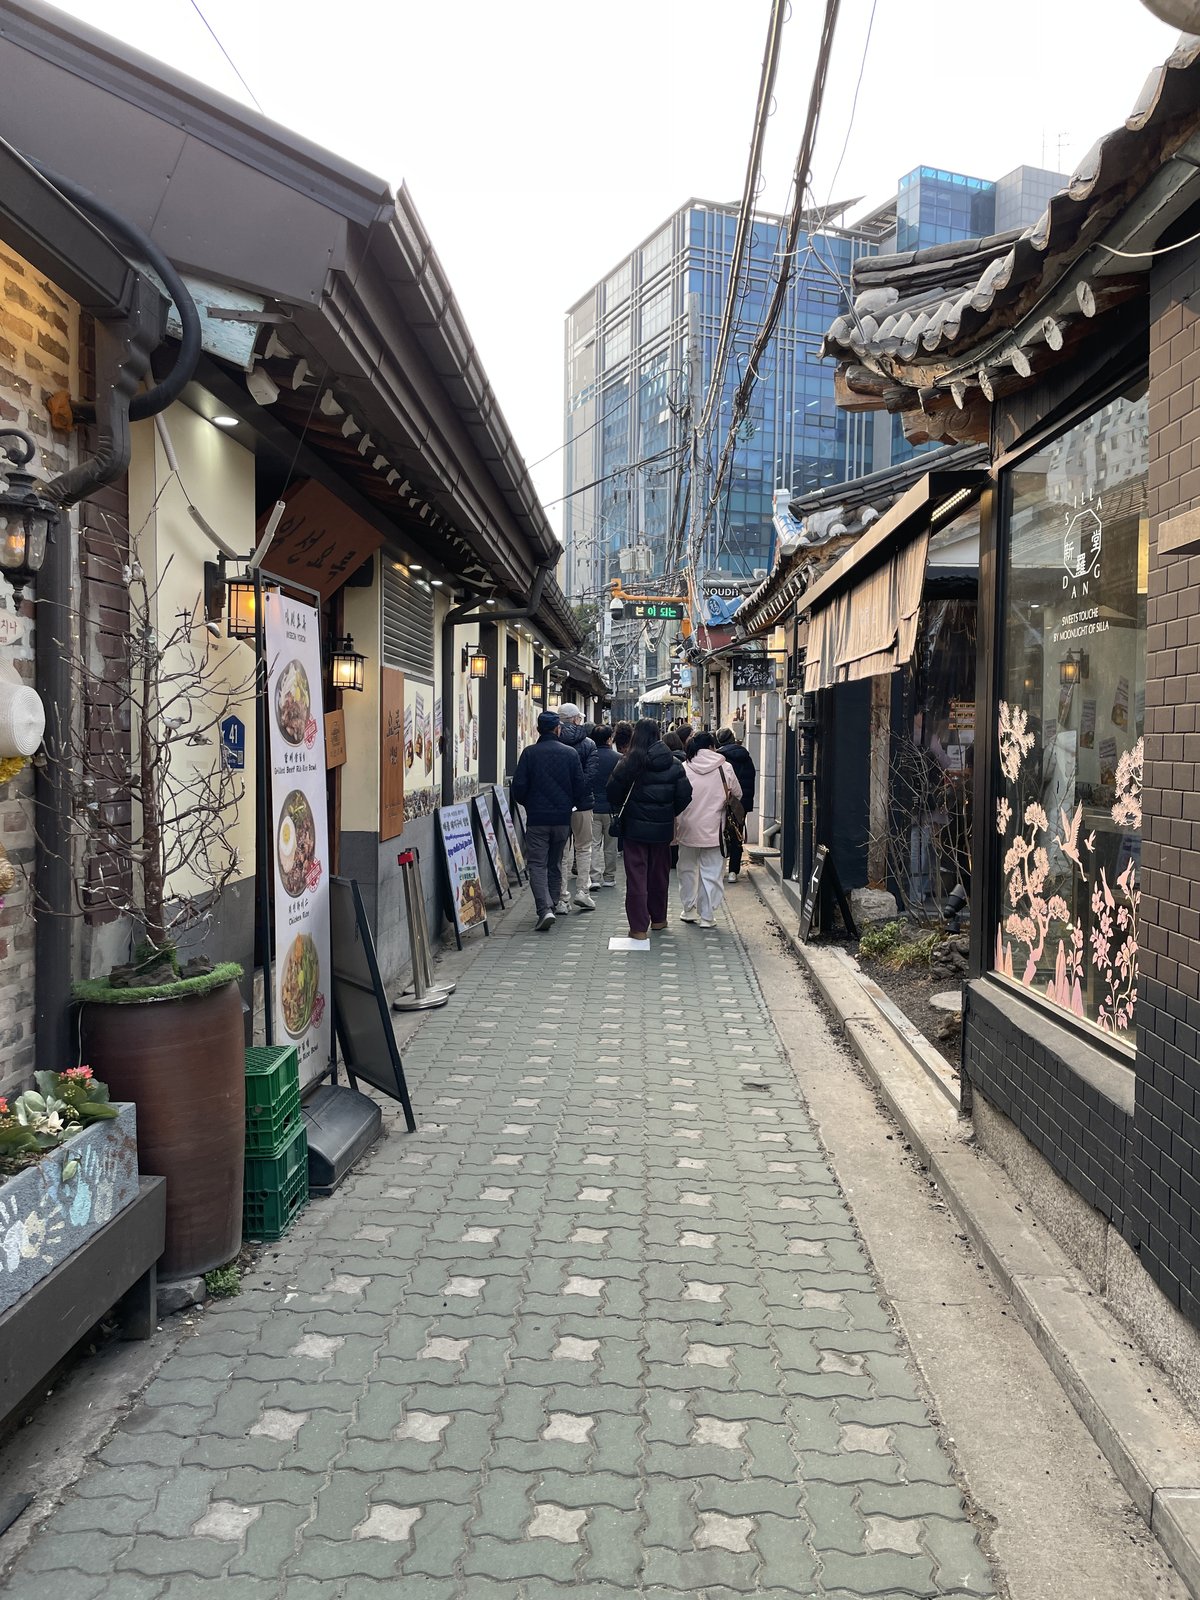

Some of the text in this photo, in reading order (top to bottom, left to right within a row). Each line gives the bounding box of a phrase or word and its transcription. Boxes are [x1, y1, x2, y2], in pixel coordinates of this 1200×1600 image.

[1065, 488, 1102, 526] SILLA
[1062, 563, 1100, 599] DANG
[1061, 607, 1099, 626] SWEETS TOUCHE
[1053, 620, 1110, 643] BY MOONLIGHT OF SILLA
[229, 724, 238, 744] 41
[288, 914, 302, 925] Chicken
